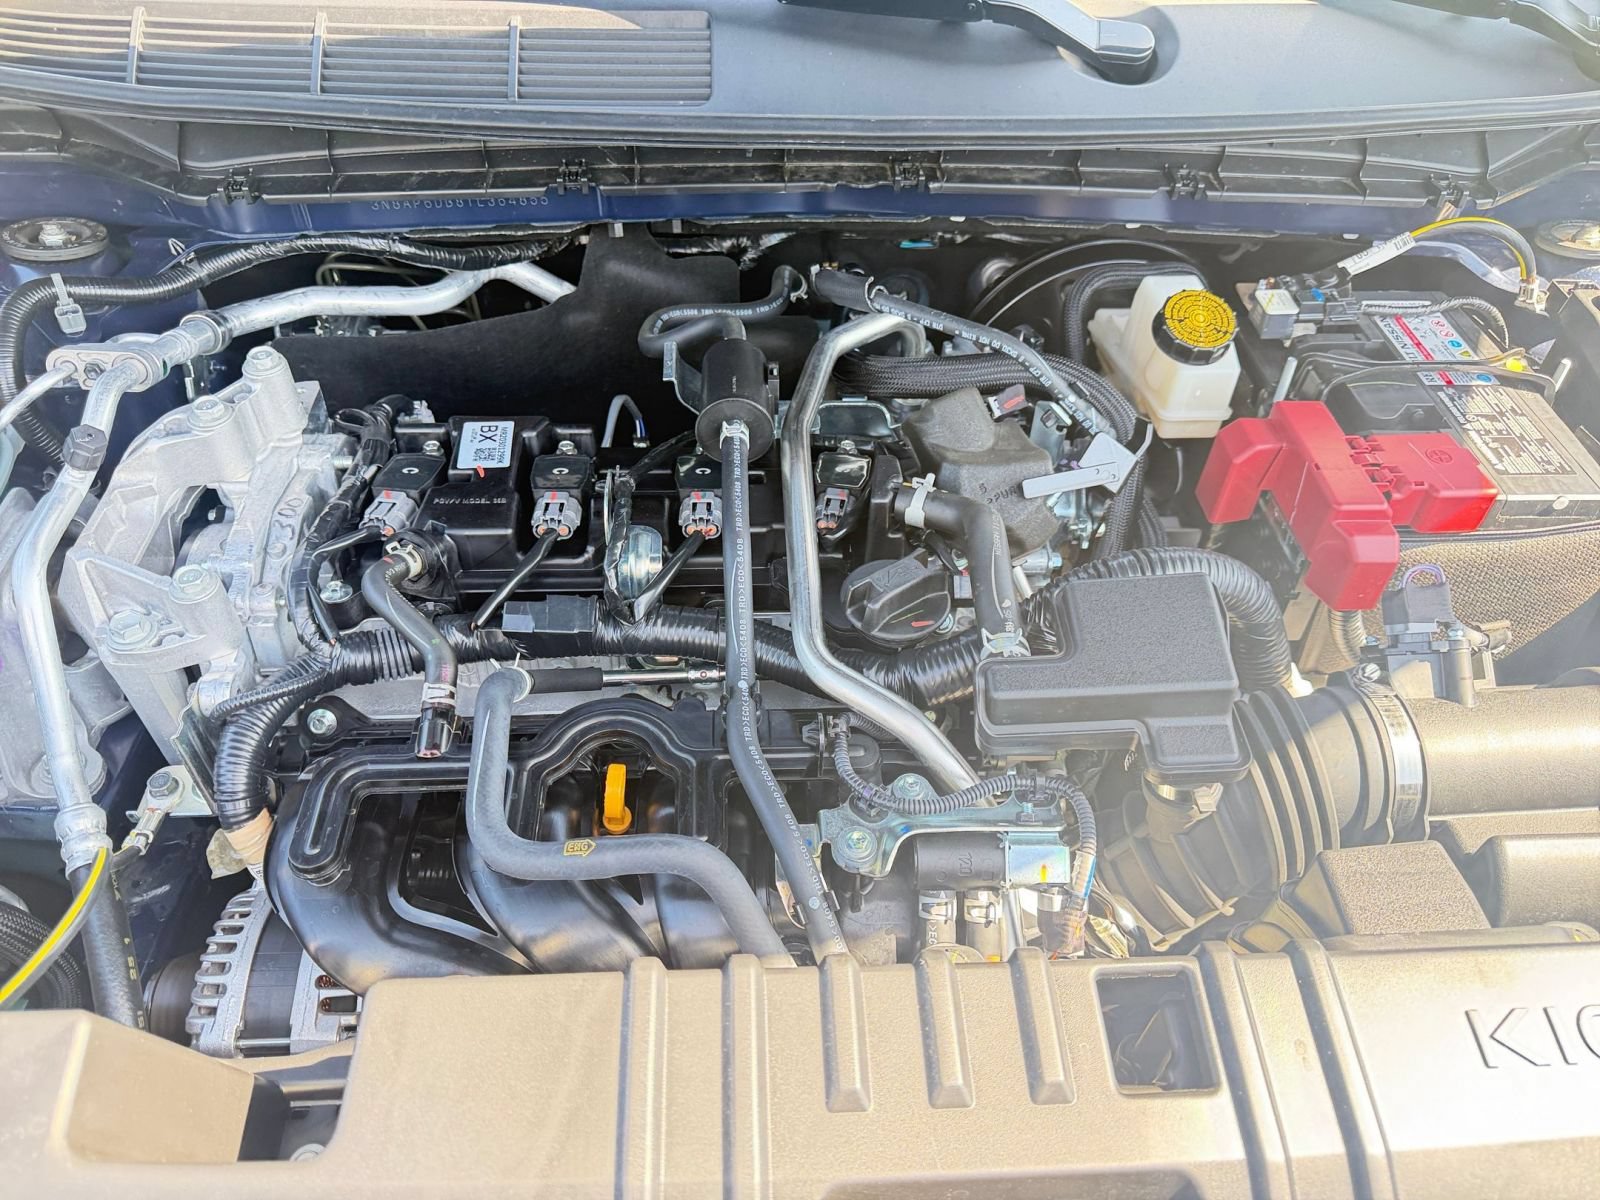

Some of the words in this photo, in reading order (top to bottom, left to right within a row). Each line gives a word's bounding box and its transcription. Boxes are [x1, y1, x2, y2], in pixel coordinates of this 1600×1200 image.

[479, 424, 498, 443] BX
[552, 467, 570, 475] C
[567, 842, 588, 852] ENG
